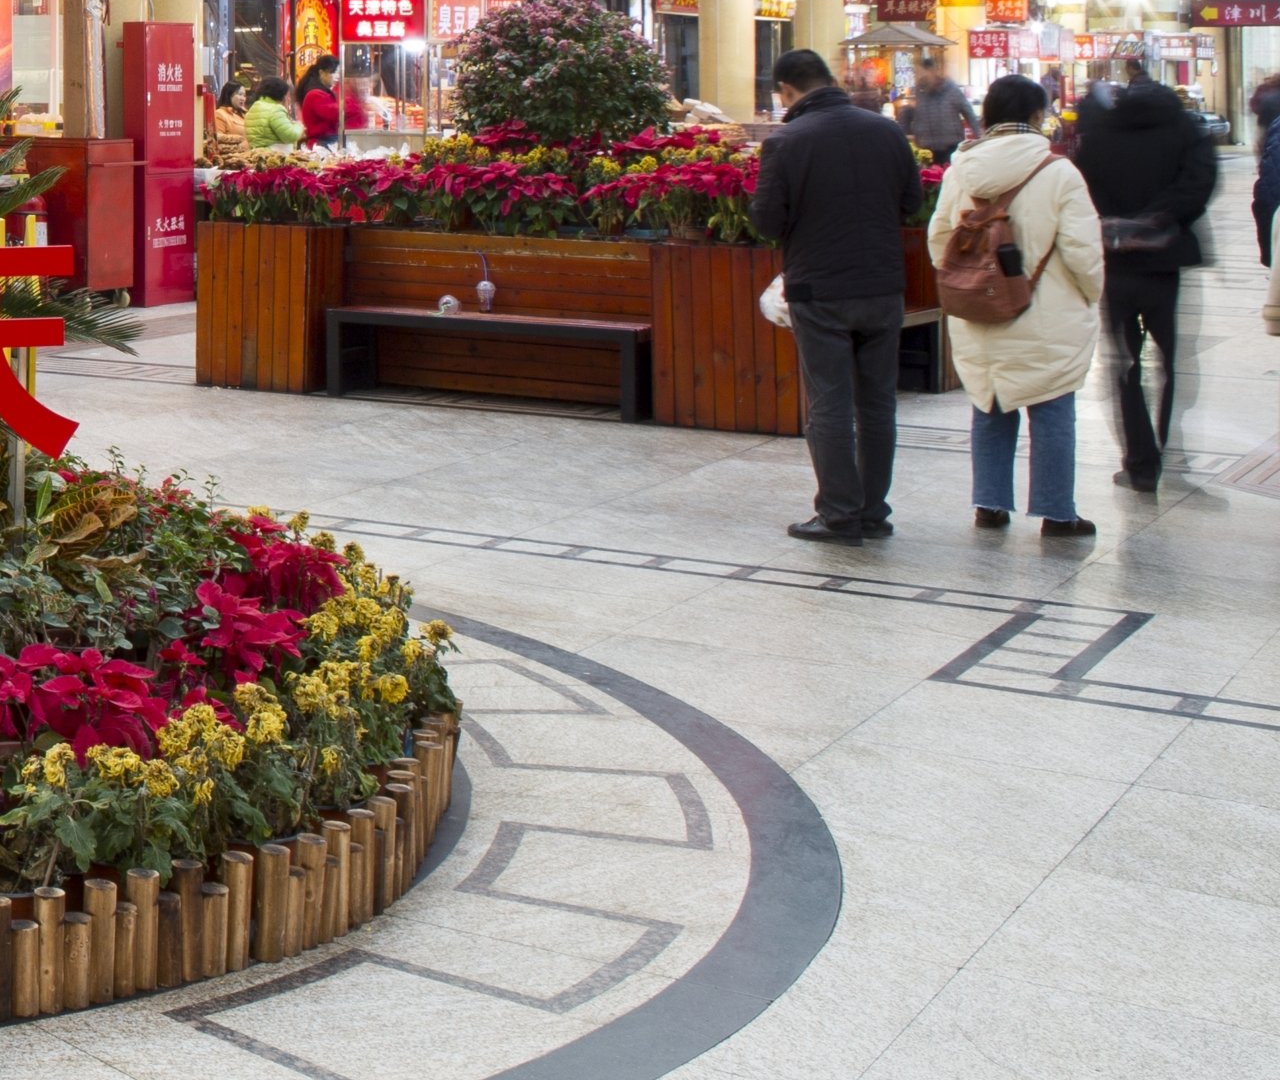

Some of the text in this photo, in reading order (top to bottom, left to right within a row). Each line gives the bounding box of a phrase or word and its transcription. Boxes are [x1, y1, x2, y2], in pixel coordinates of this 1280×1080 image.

[348, 0, 414, 16] 天津特色
[157, 63, 183, 82] 消火栓
